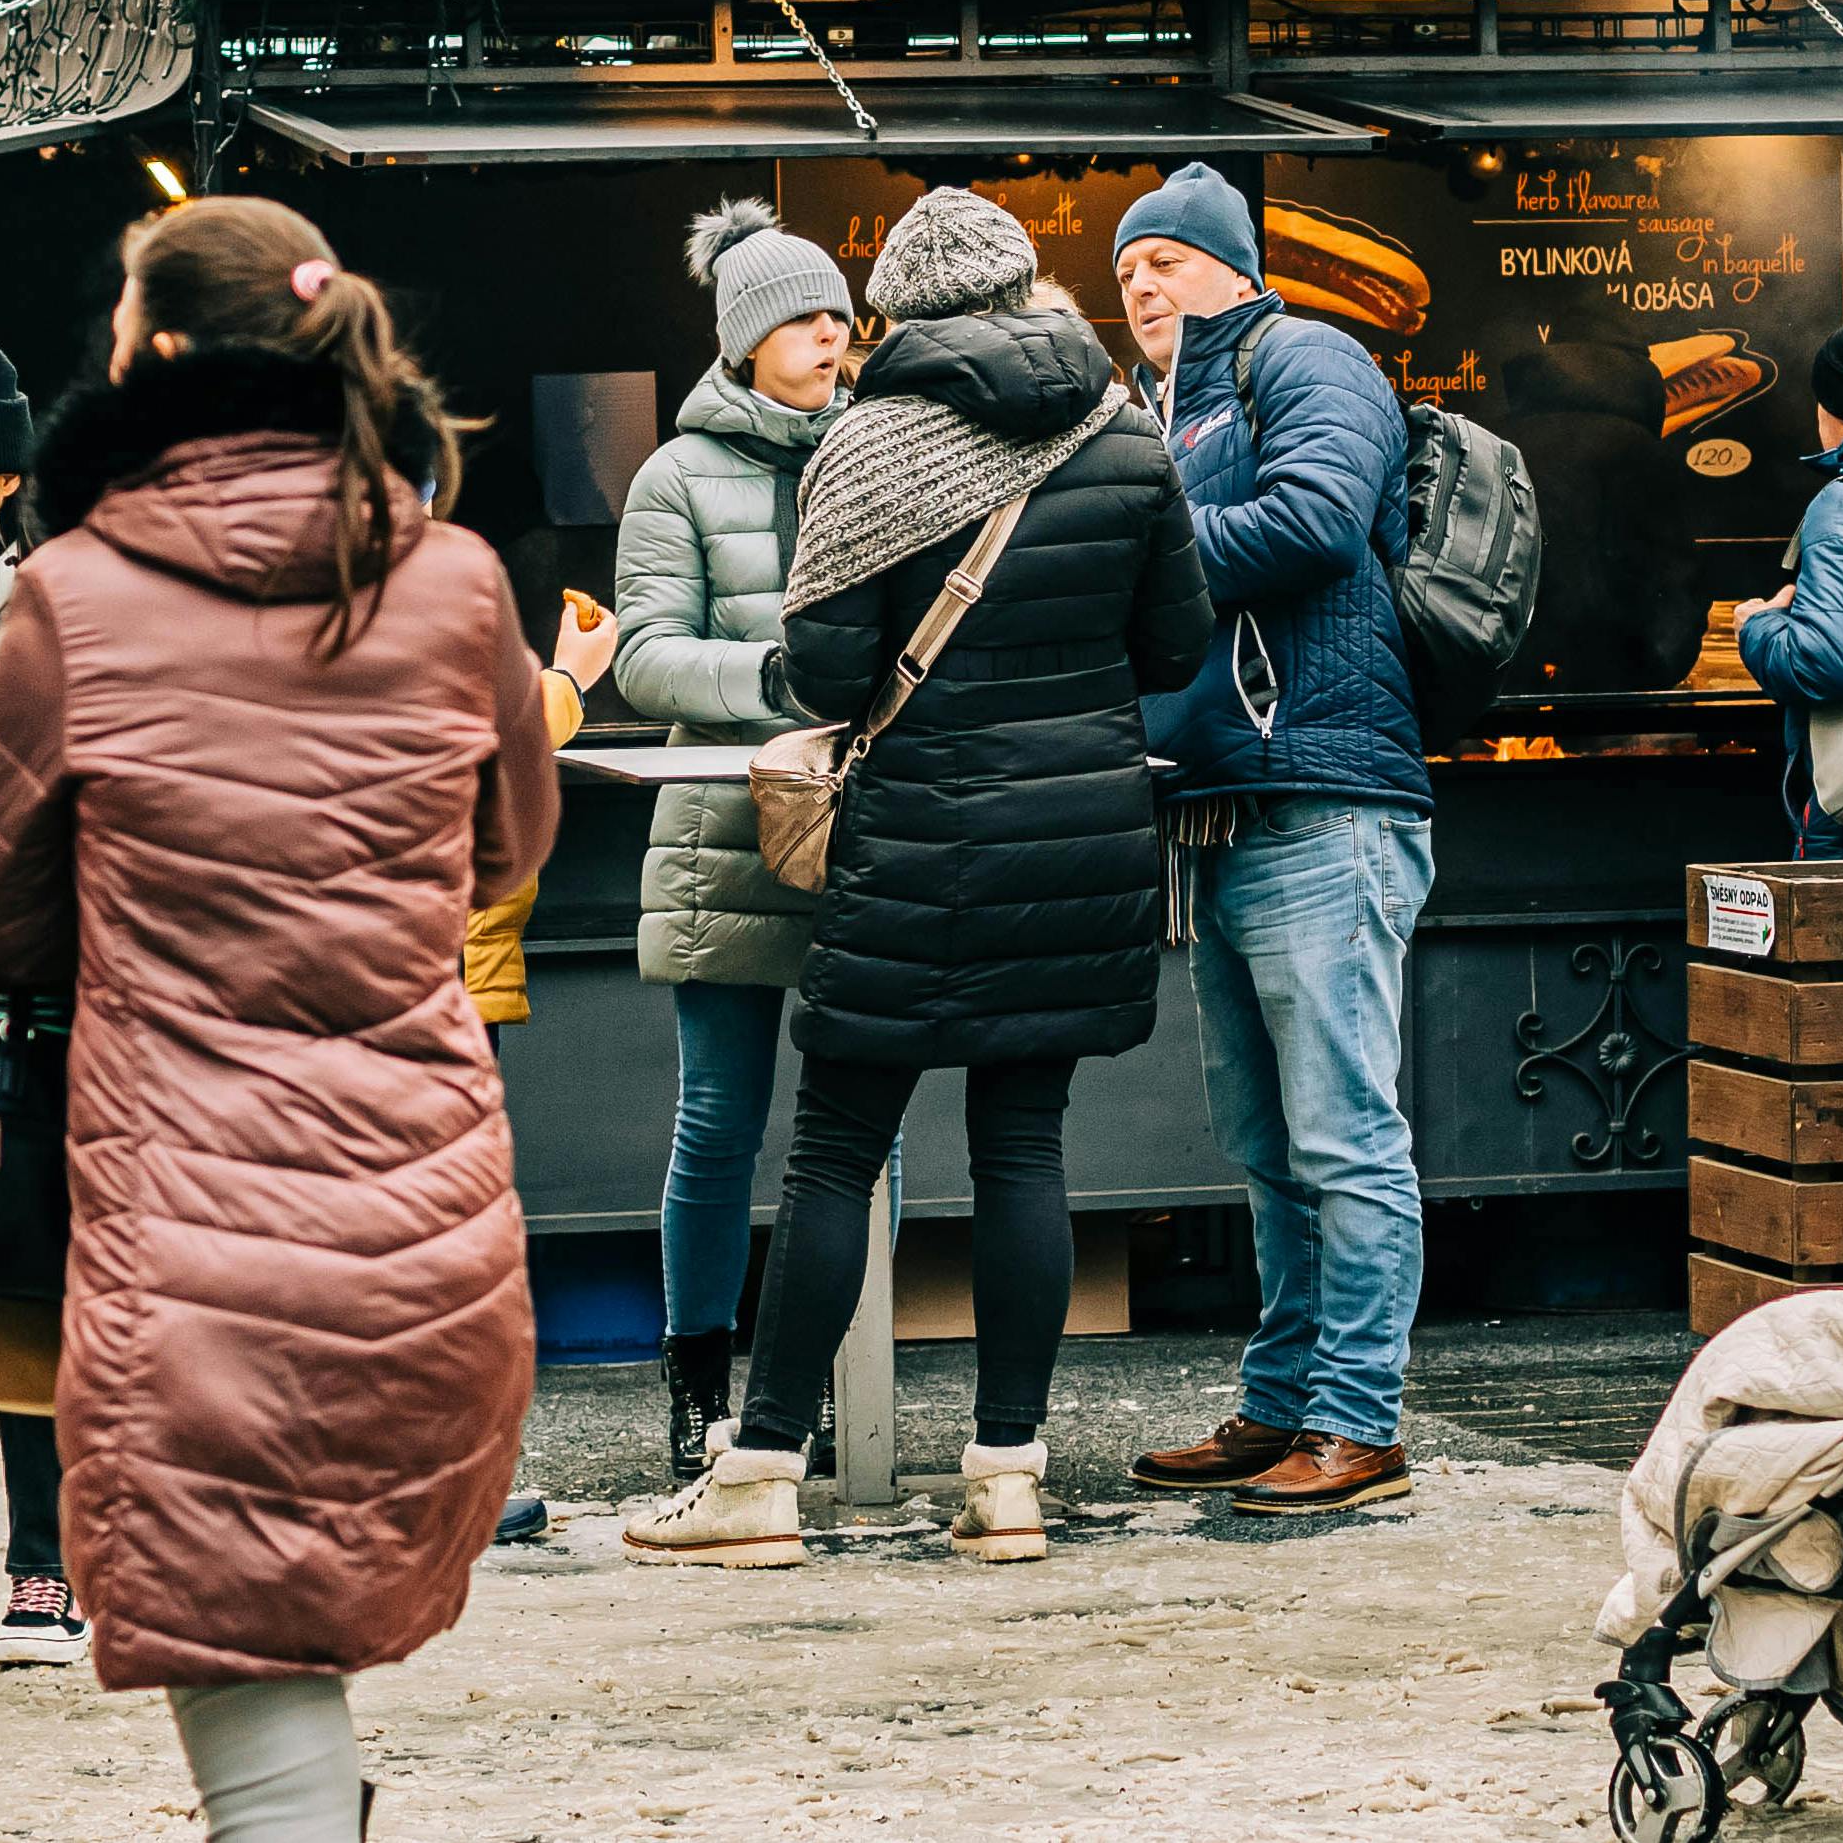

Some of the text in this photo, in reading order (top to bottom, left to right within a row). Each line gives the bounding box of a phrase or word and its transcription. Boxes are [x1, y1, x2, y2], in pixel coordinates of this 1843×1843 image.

[1516, 169, 1560, 212] herb
[1501, 239, 1634, 276] BYLINKOVÁ
[1637, 216, 1716, 263] sausage
[1702, 232, 1806, 304] in baguette
[1394, 349, 1487, 408] baguette
[1739, 889, 1769, 907] ODPAD
